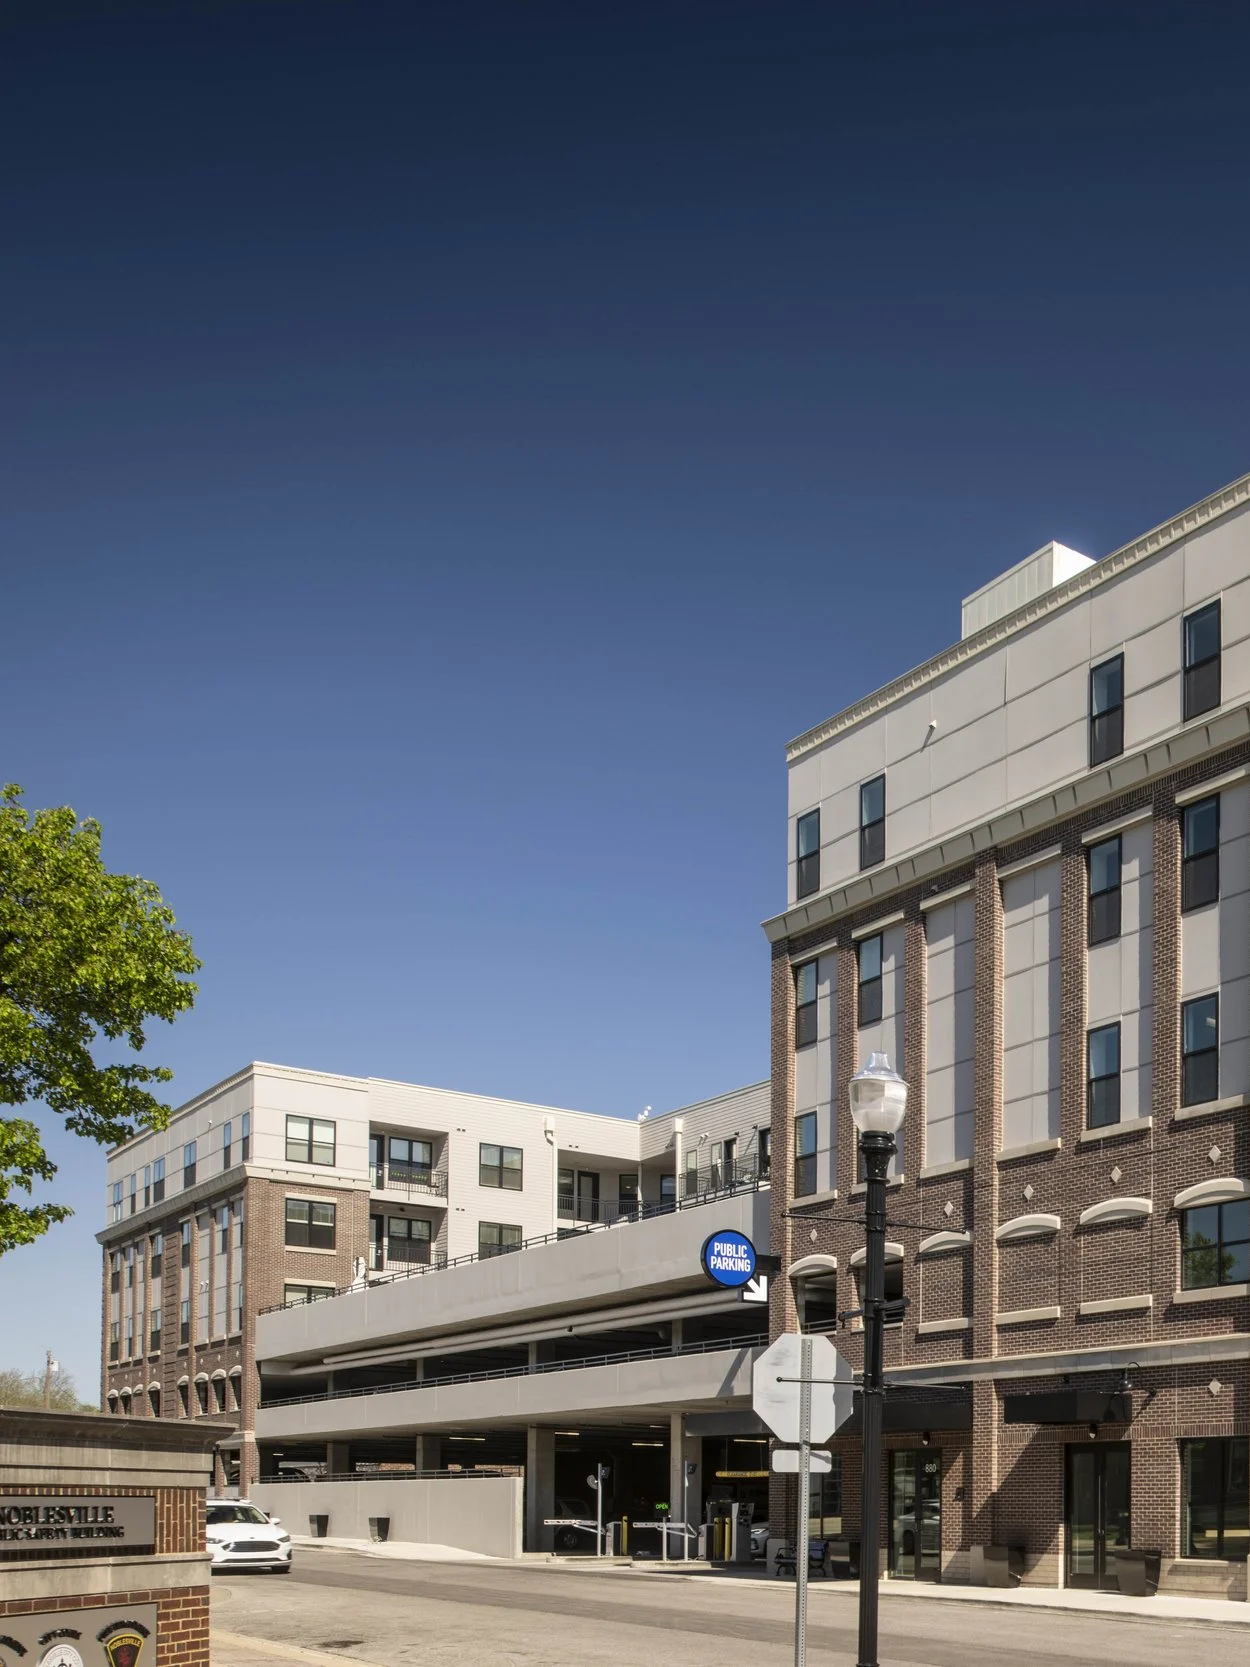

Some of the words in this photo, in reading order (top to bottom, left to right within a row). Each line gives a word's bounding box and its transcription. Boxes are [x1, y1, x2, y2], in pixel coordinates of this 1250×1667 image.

[714, 1242, 748, 1258] PUBLIC
[710, 1255, 751, 1272] PARKING
[69, 1526, 125, 1539] BUILDING
[110, 1637, 141, 1651] NOBLESVILLE
